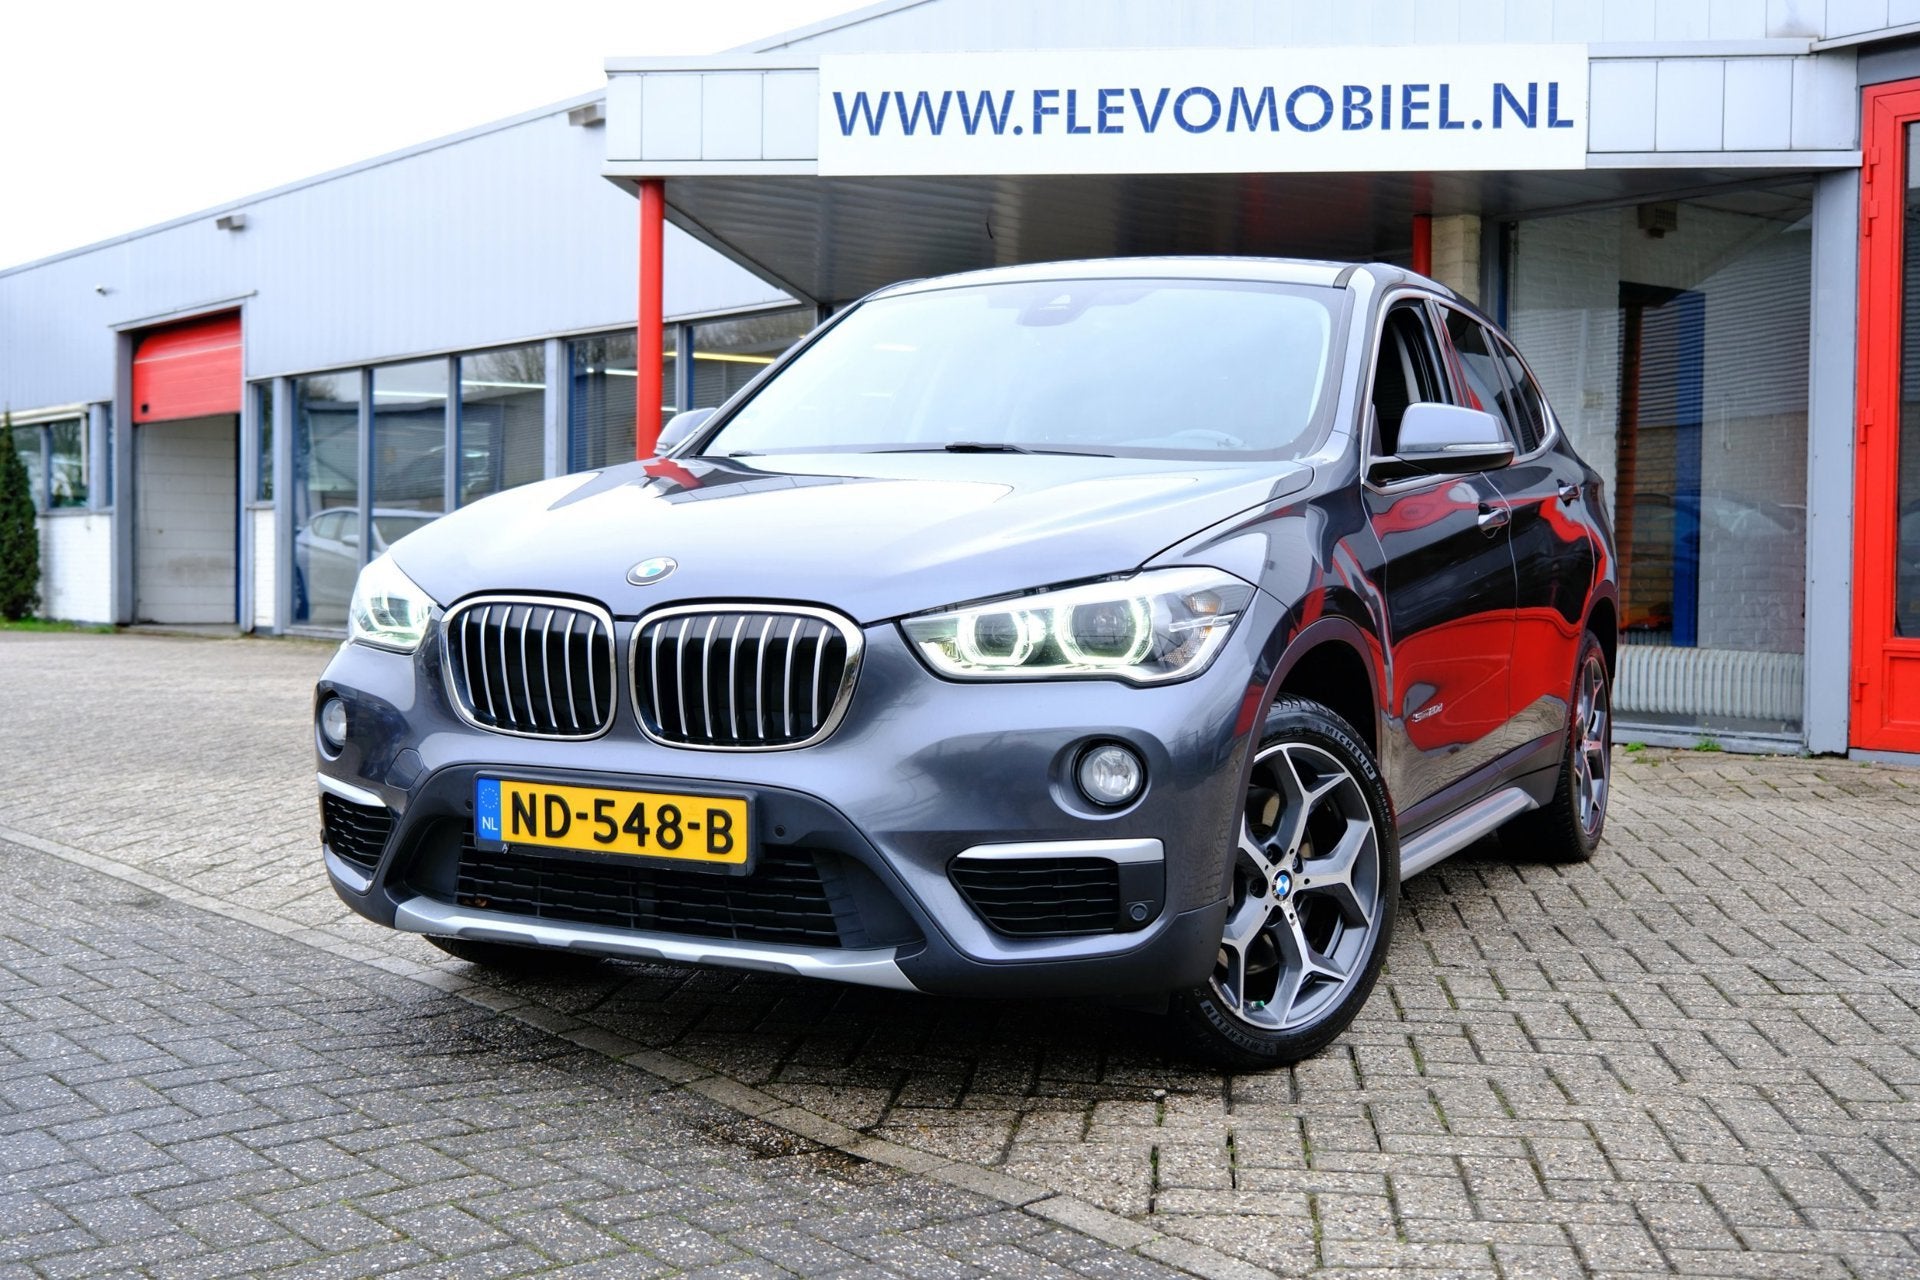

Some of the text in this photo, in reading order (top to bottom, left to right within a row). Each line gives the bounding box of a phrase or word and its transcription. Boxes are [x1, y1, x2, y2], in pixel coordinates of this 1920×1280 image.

[832, 81, 1574, 136] WWW.FLEVOMOBIEL.NL
[1324, 725, 1374, 777] MICHELIN
[482, 816, 499, 831] NL
[511, 791, 734, 855] ND-548-B
